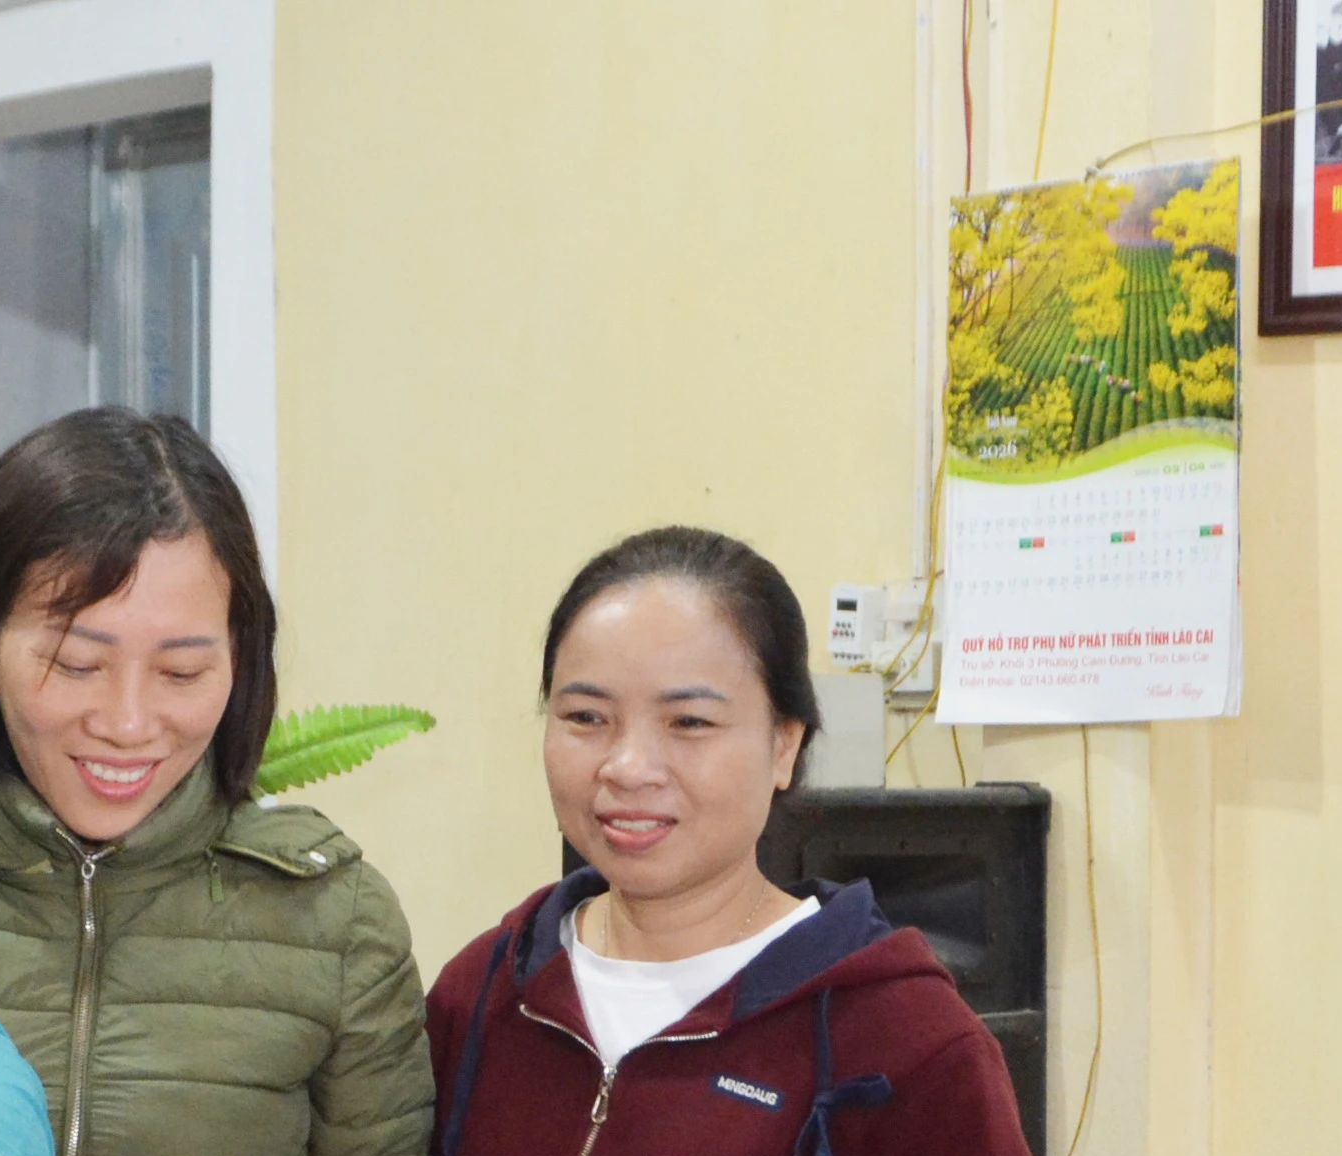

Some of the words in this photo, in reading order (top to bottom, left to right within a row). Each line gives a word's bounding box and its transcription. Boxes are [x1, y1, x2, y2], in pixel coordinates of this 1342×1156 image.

[1007, 634, 1030, 654] TRỢ
[1032, 634, 1056, 653] PHỤ
[1078, 629, 1108, 649] PHÁT
[1145, 625, 1170, 646] TỈNH
[1172, 627, 1193, 646] LÀO
[1196, 628, 1214, 645] CAI
